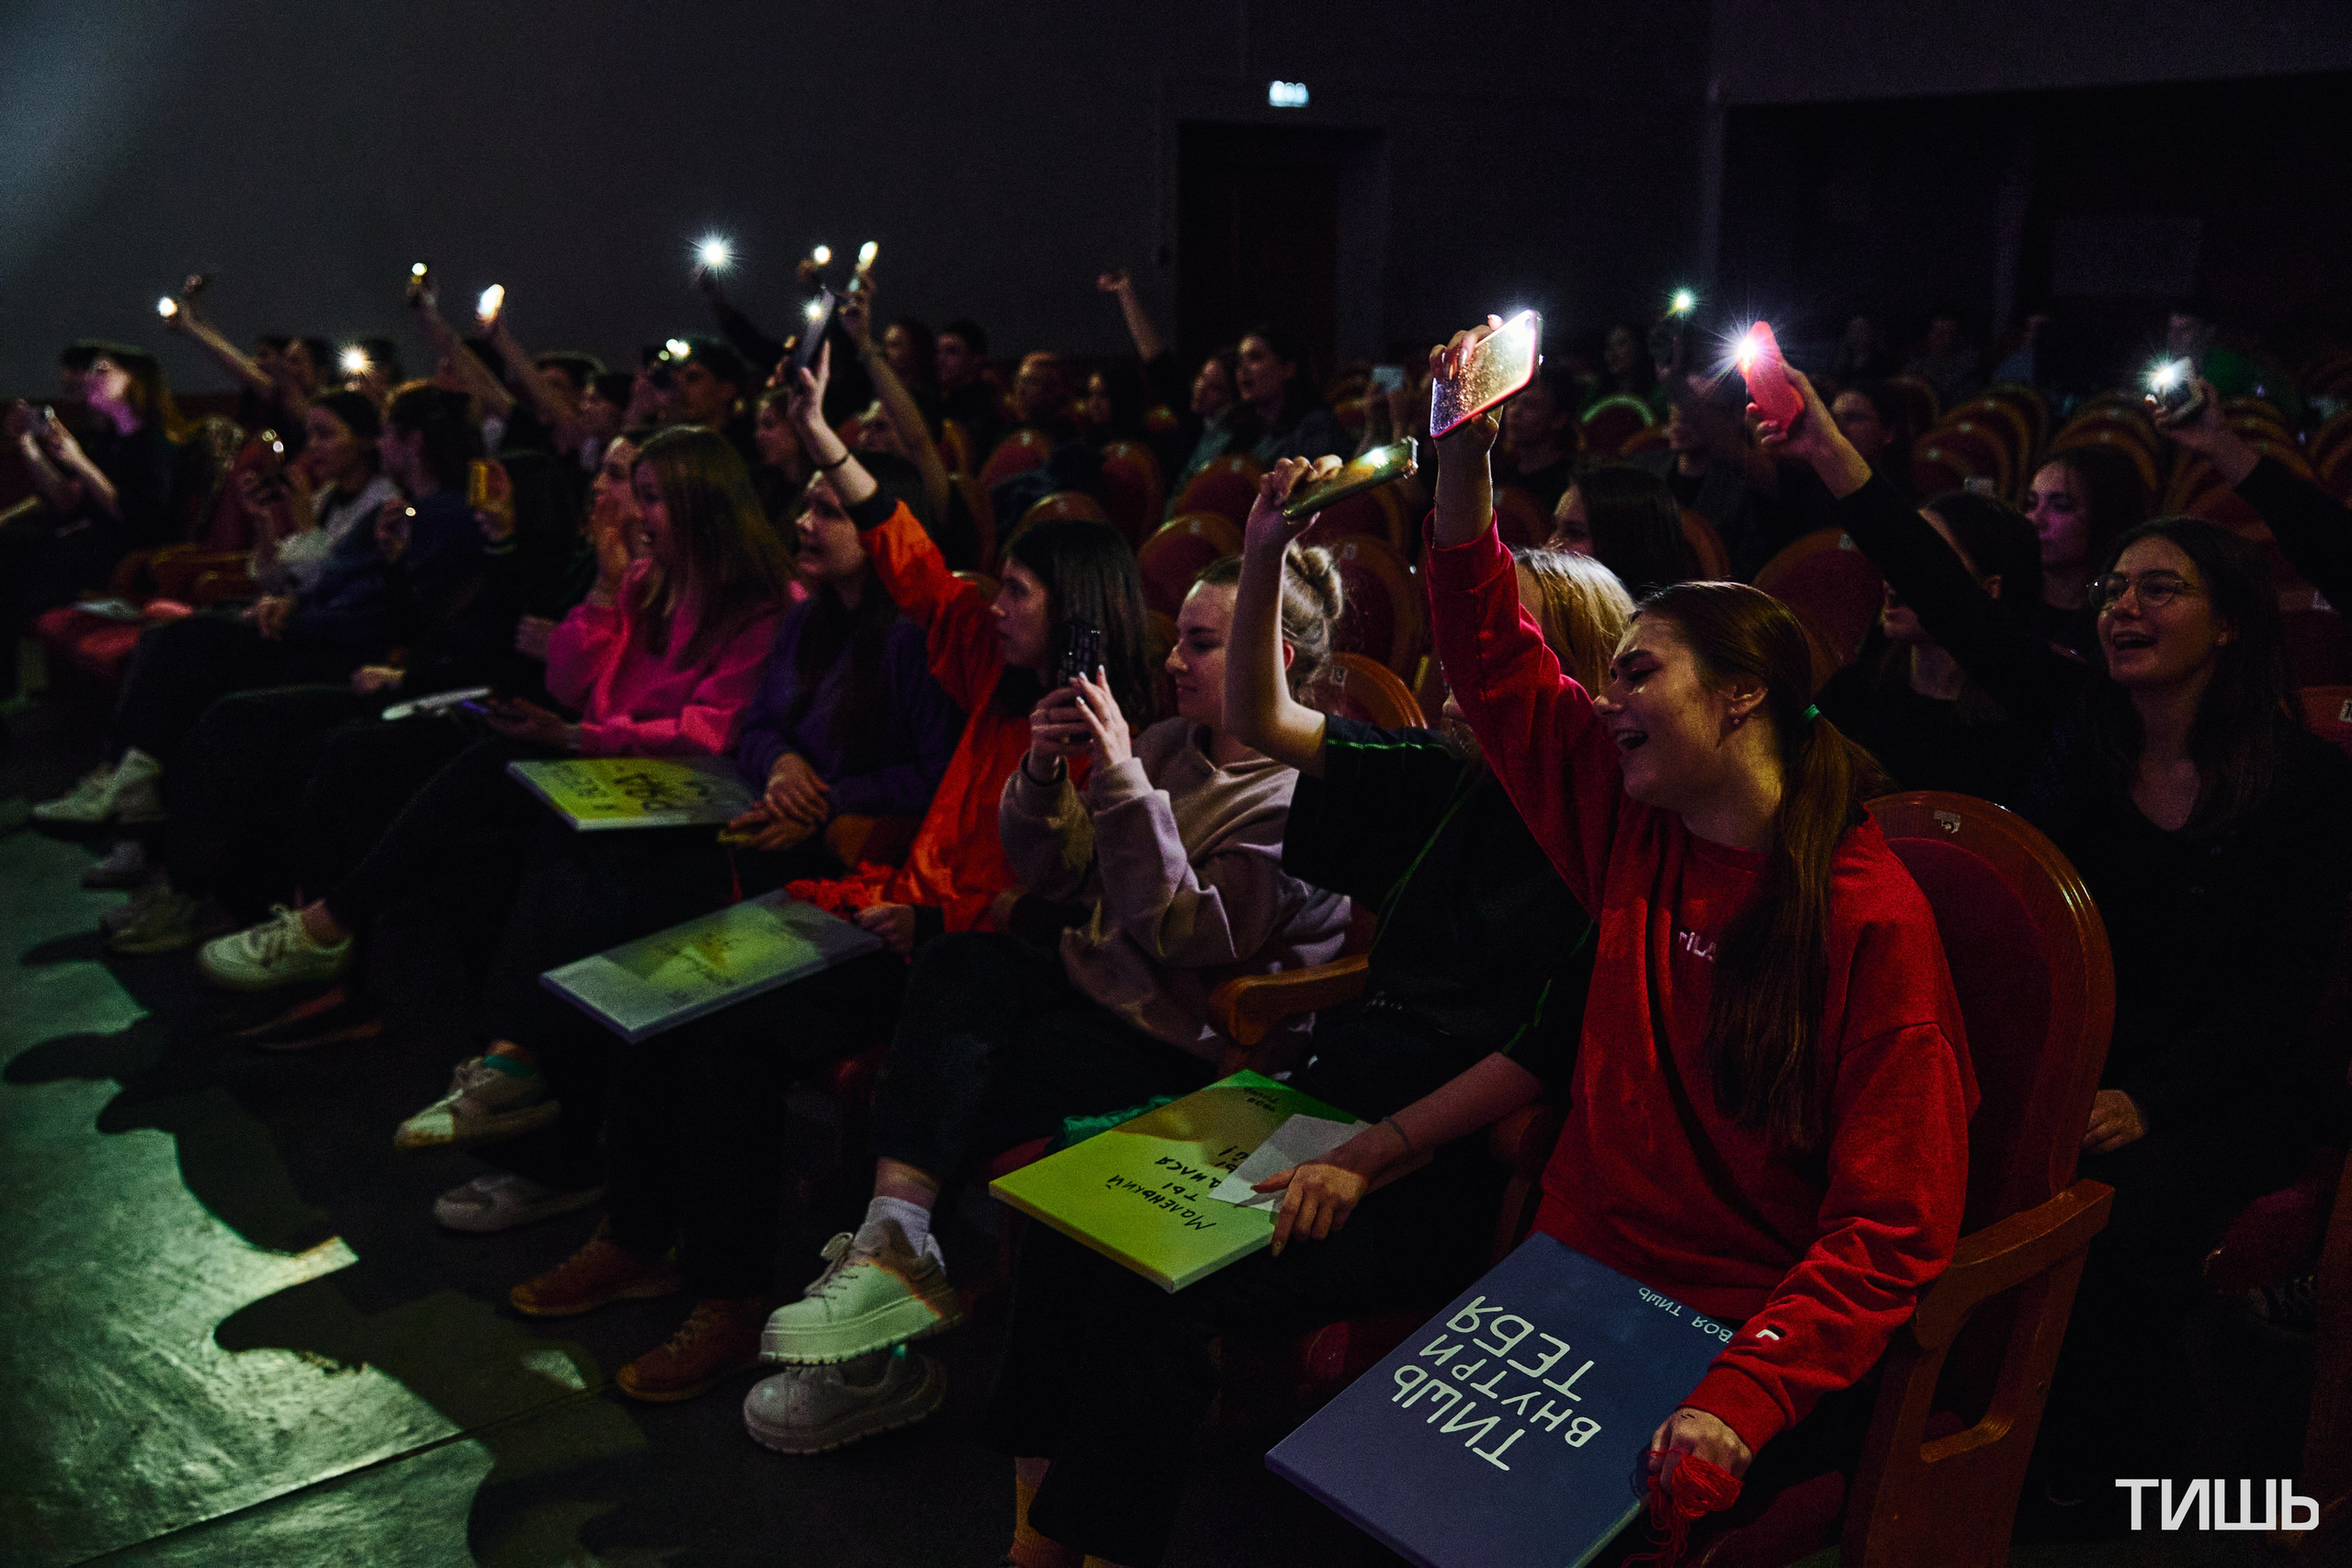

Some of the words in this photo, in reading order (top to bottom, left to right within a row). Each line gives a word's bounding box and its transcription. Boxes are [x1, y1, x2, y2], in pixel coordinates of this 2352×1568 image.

[1445, 1295, 1595, 1403] ТЕБЯ
[1638, 1287, 1682, 1317] ТИШЬ
[1690, 1315, 1734, 1344] ВОЯ
[1391, 1364, 1526, 1472] ТИШЬ
[1419, 1333, 1602, 1449] ВНУТРИ
